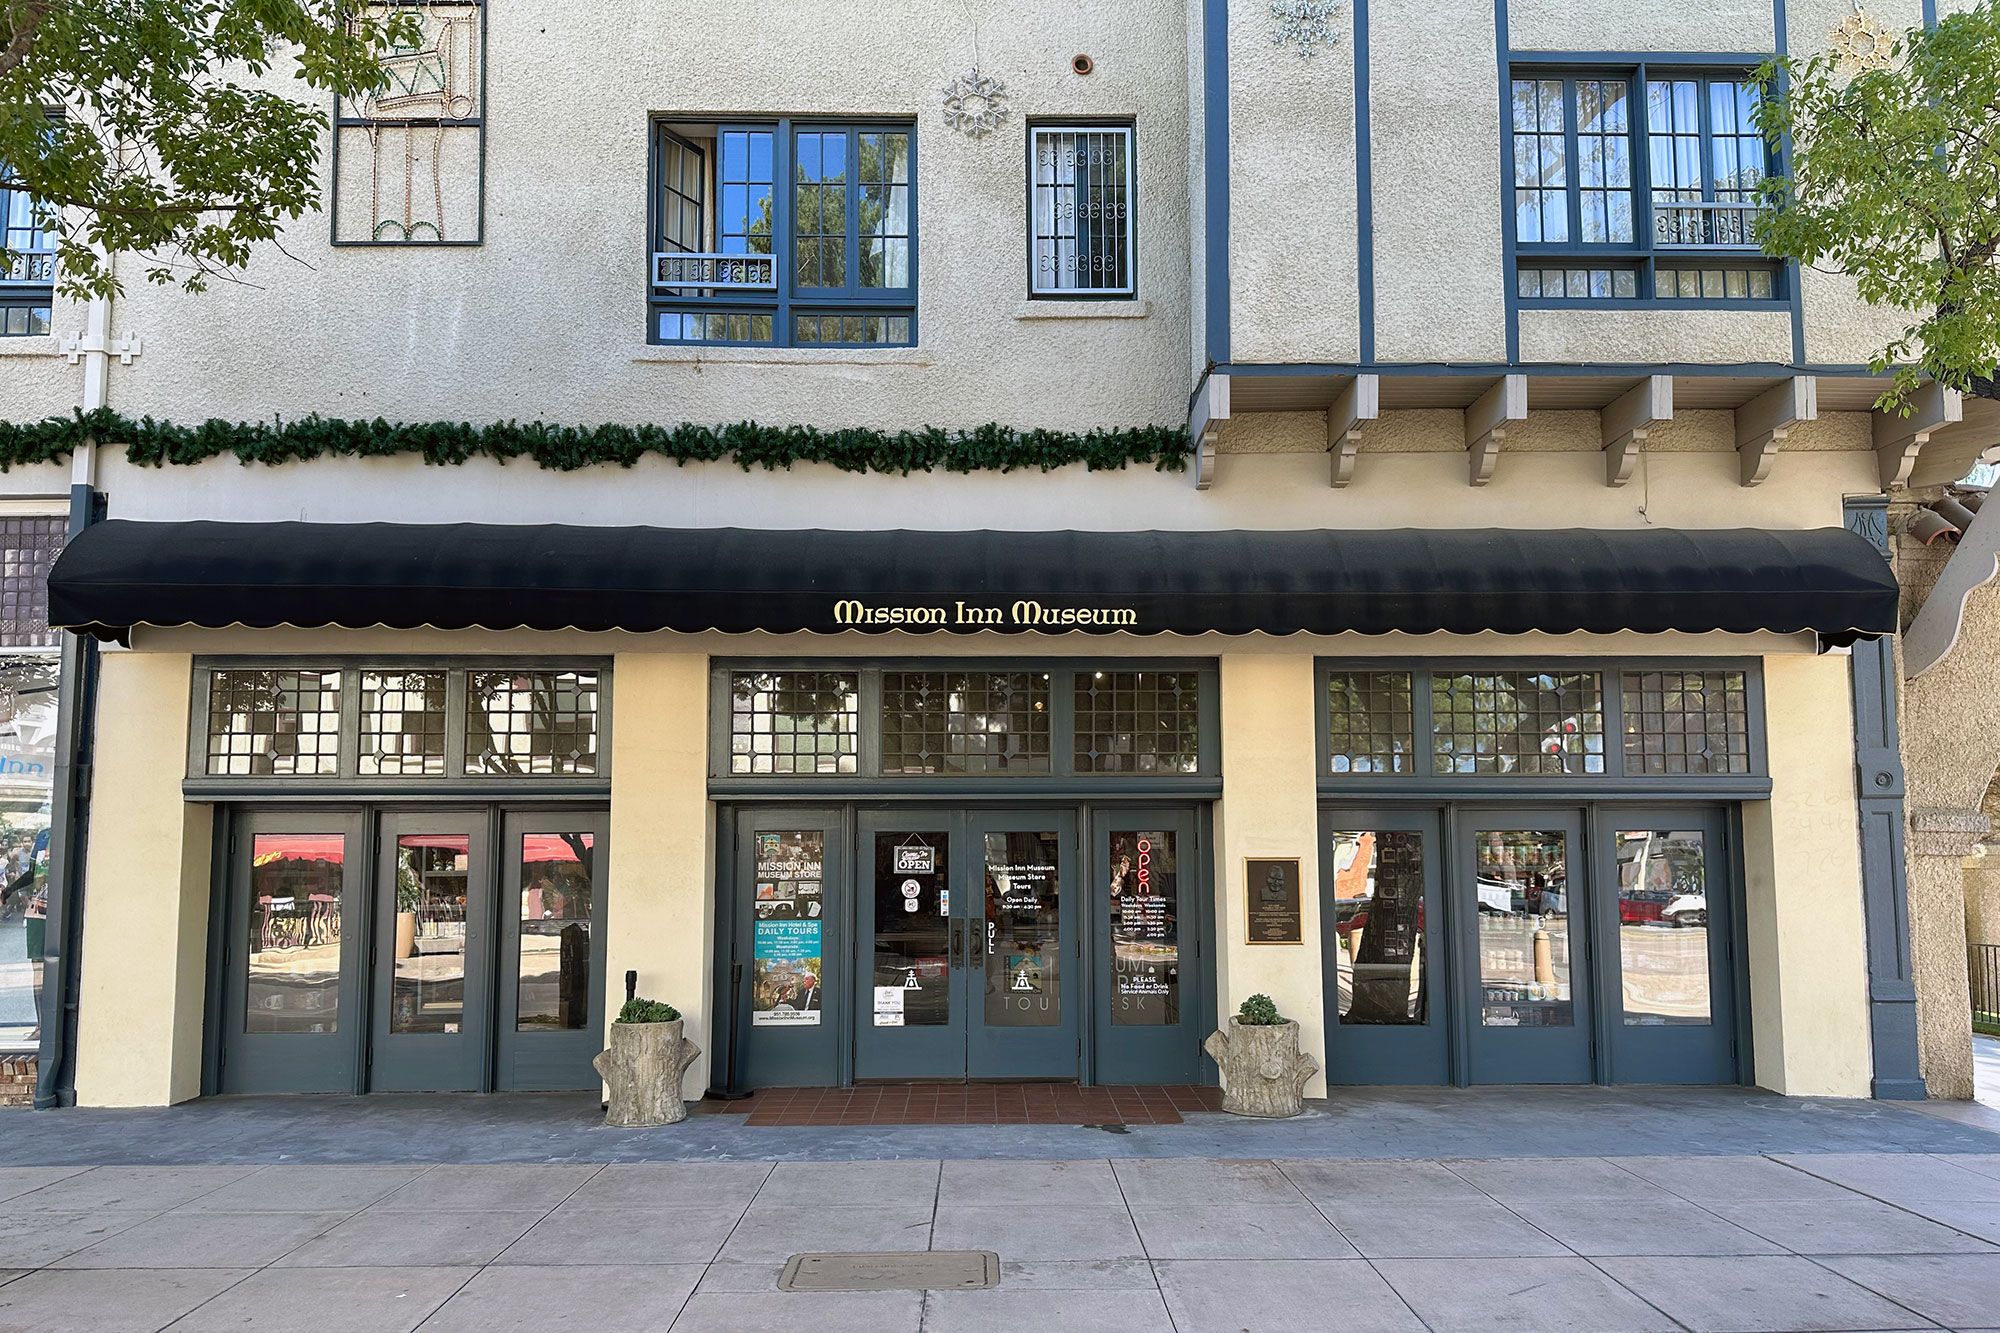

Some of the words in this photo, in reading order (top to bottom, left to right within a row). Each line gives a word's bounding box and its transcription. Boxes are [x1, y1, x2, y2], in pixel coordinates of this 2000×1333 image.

[833, 600, 948, 625] Mission
[955, 601, 1004, 625] Inn
[1011, 600, 1138, 625] Museum
[758, 862, 800, 871] MISSION
[804, 862, 821, 871] INN
[898, 860, 930, 869] OPEN
